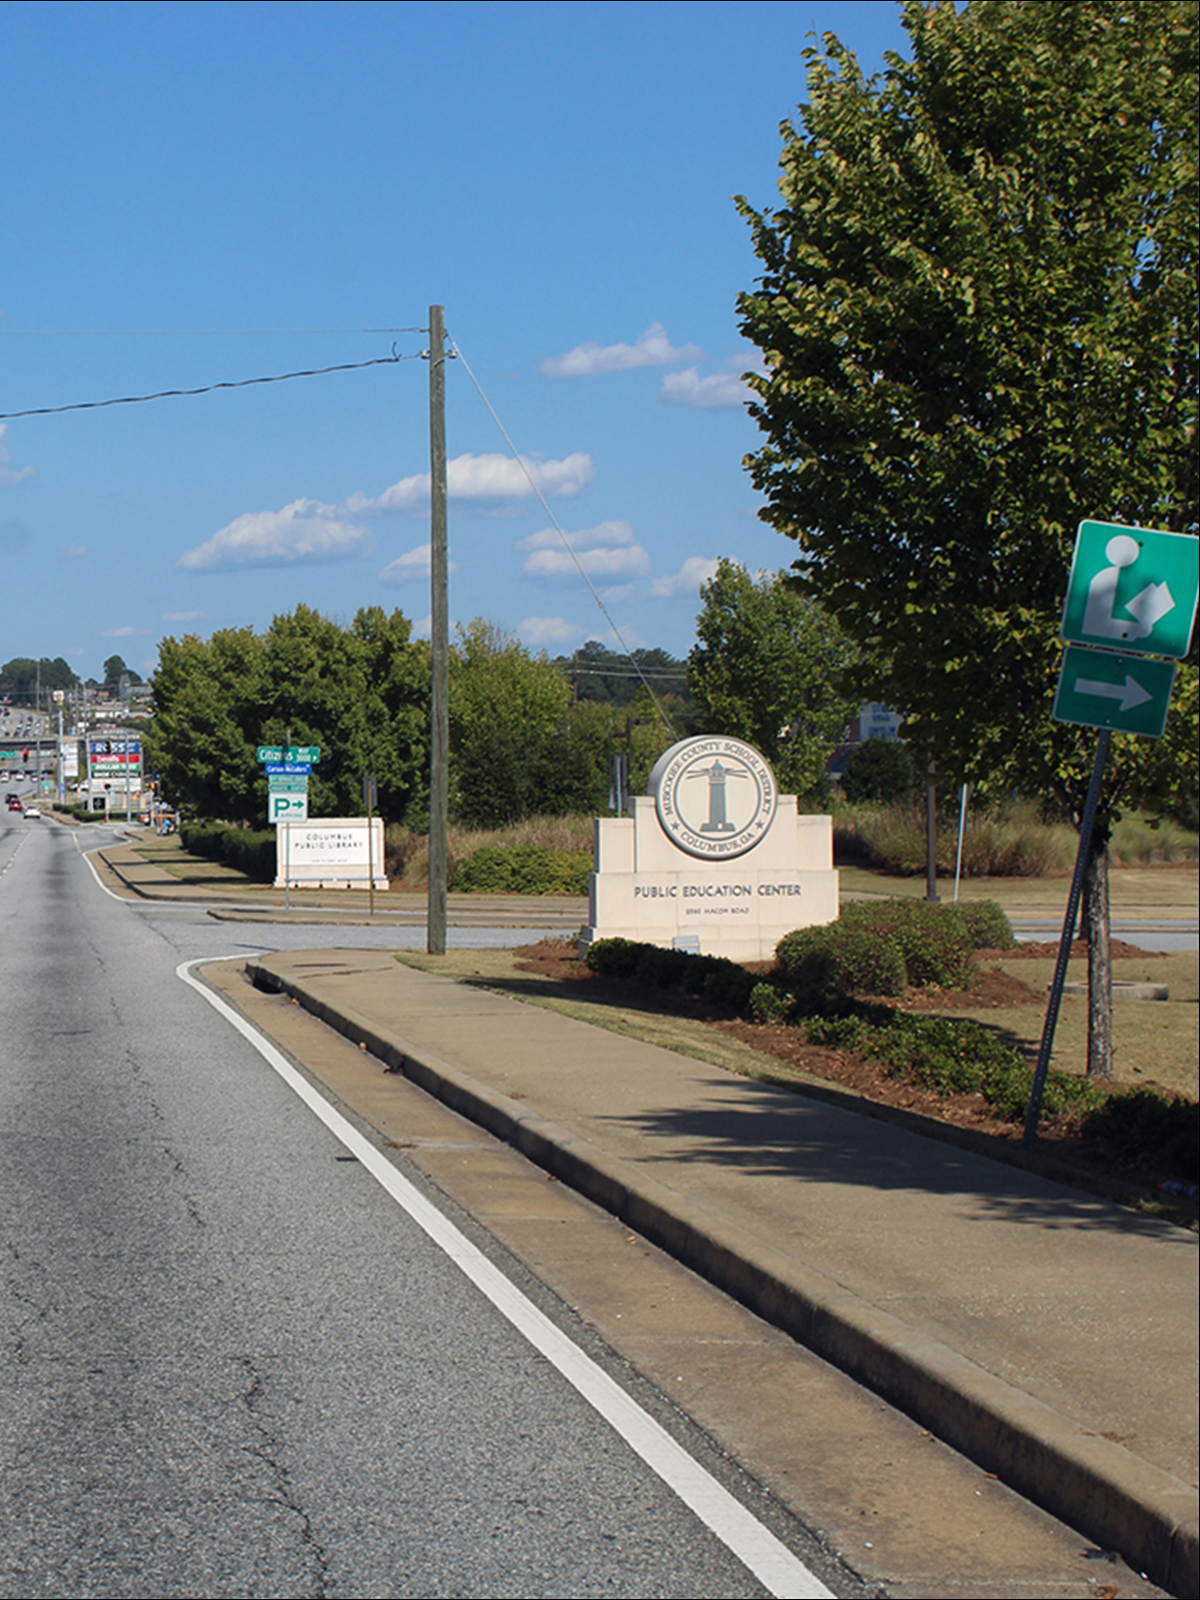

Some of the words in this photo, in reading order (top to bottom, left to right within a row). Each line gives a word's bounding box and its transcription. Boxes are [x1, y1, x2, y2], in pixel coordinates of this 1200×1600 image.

[662, 758, 683, 816] MUSCOGEE
[681, 741, 722, 763] COUNTY
[724, 742, 760, 769] SCHOOL
[757, 768, 774, 816] DISTRICT
[306, 833, 353, 841] COLUMBUS
[634, 885, 678, 898] PUBLIC
[683, 884, 752, 898] EDUCATION
[757, 884, 802, 897] CENTER
